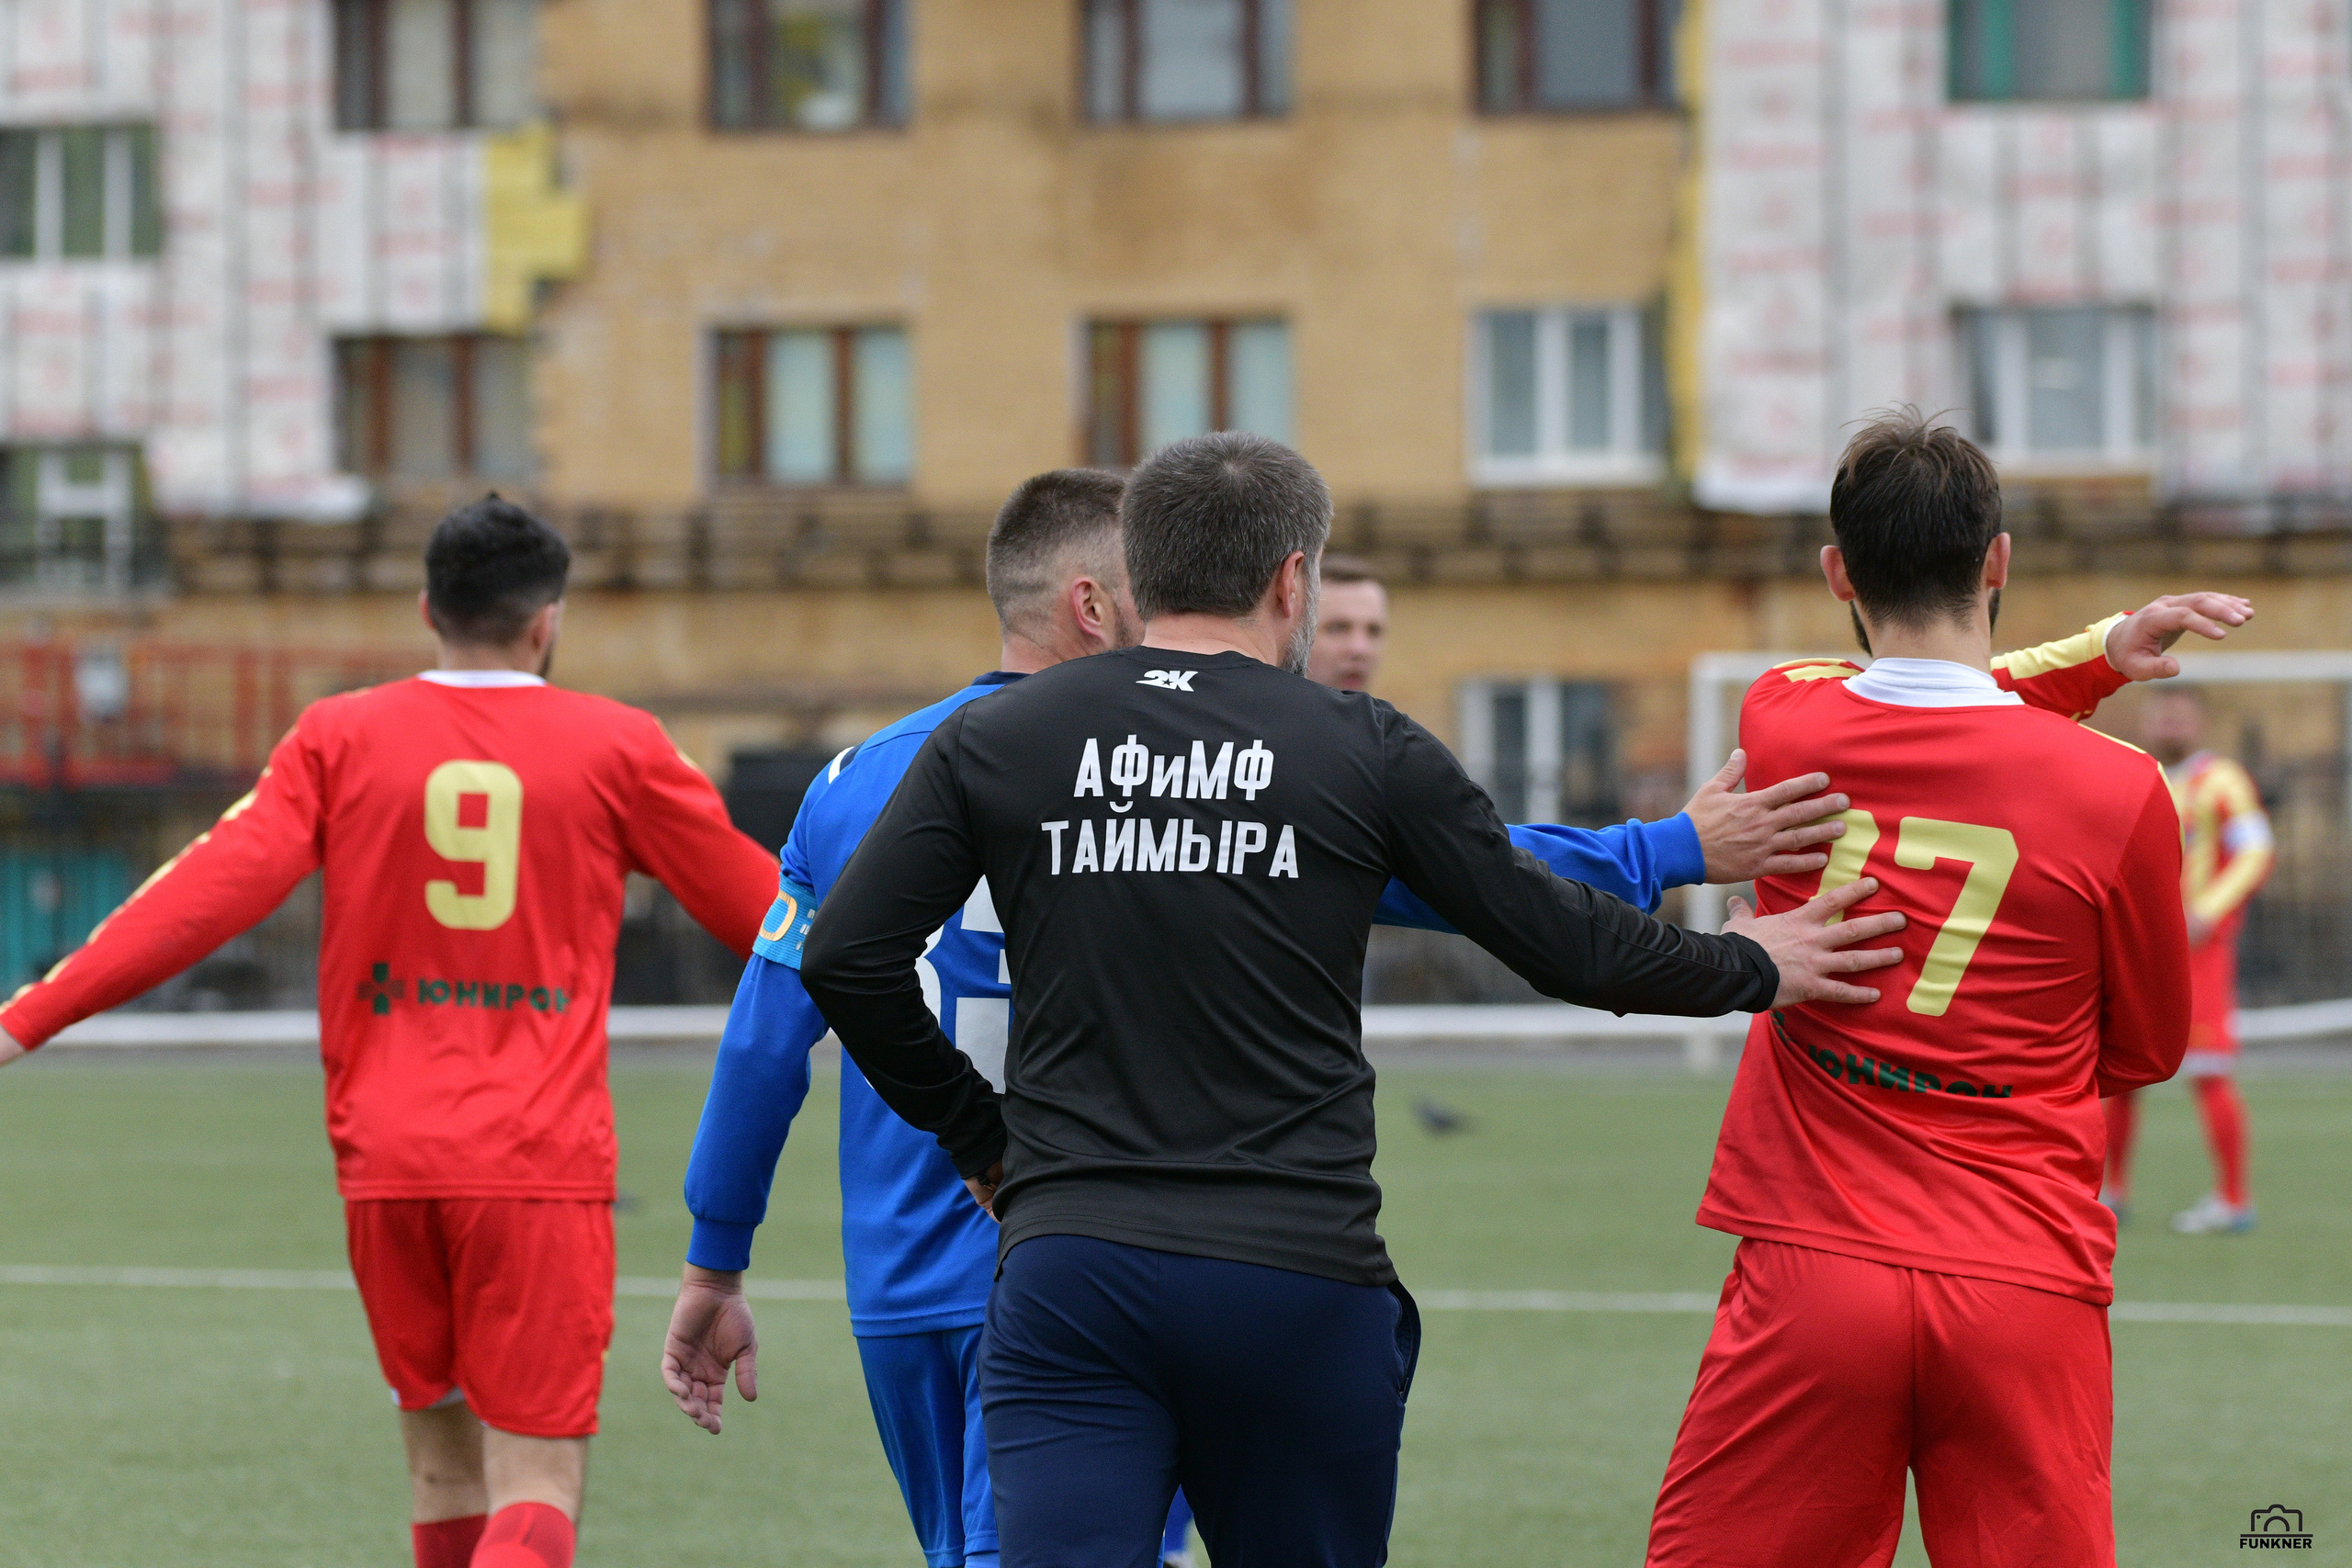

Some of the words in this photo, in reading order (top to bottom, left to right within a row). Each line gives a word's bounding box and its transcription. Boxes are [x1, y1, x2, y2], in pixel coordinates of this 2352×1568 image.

[1136, 670, 1198, 692] 2K
[1073, 734, 1274, 801] АФиМФ
[424, 759, 524, 931] 9
[1041, 800, 1299, 879] ТАЙМЫРА
[1792, 808, 2019, 1017] 77
